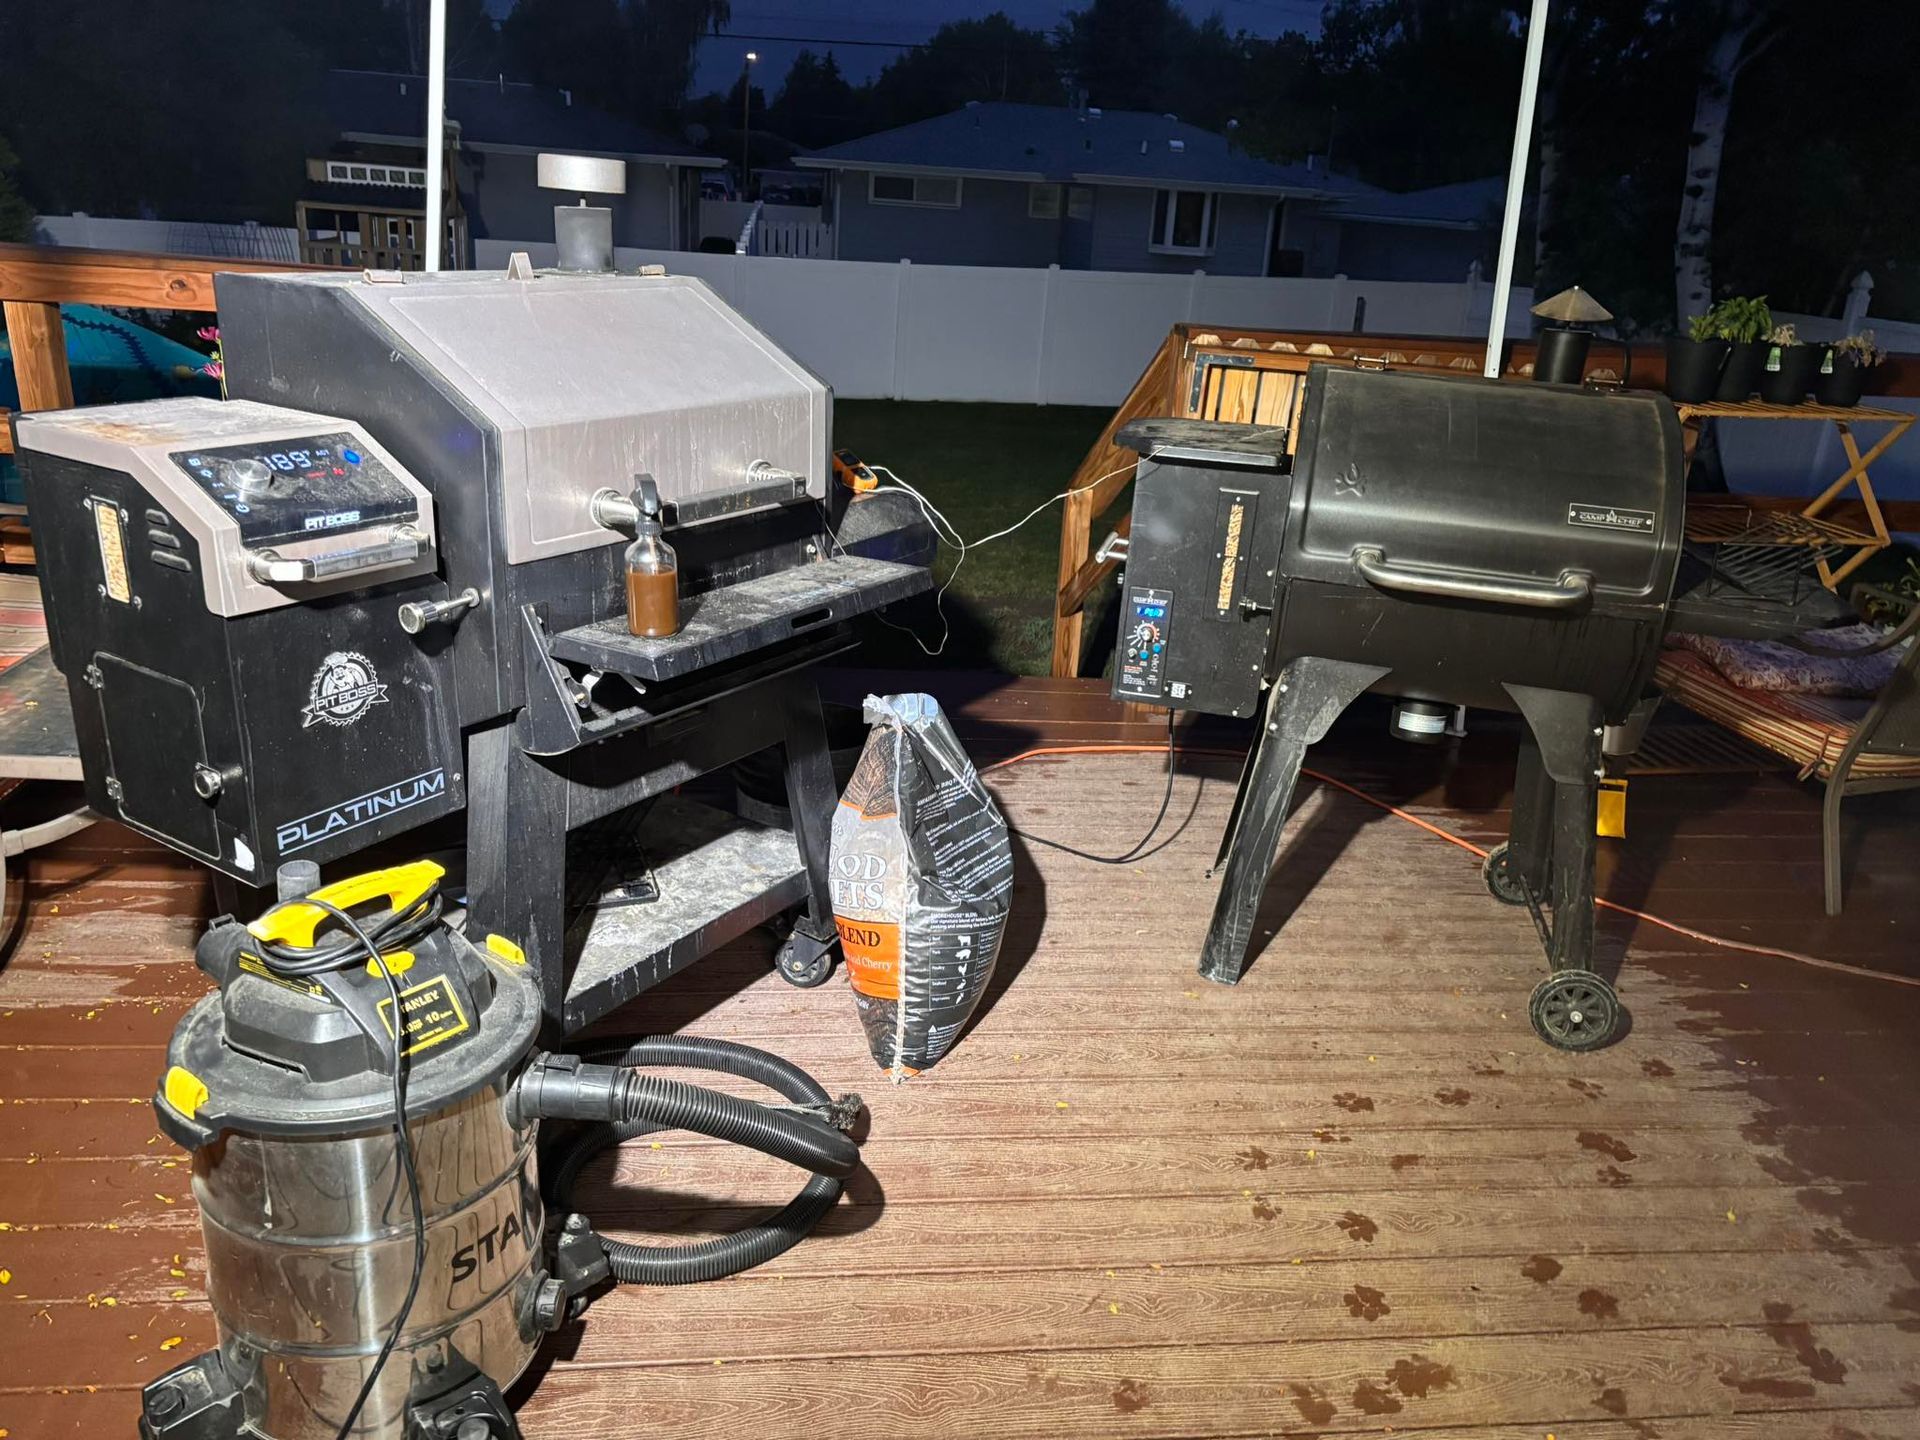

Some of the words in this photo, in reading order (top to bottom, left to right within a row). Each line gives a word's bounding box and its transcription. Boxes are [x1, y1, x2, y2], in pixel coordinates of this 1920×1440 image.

[305, 515, 326, 530] PIT
[325, 510, 361, 526] BOSS
[315, 694, 338, 712] PIT
[338, 685, 377, 704] BOSS
[277, 772, 445, 850] PLATINUM
[861, 956, 893, 972] Cherry
[400, 990, 440, 1013] TANLEY
[452, 1211, 522, 1284] STA
